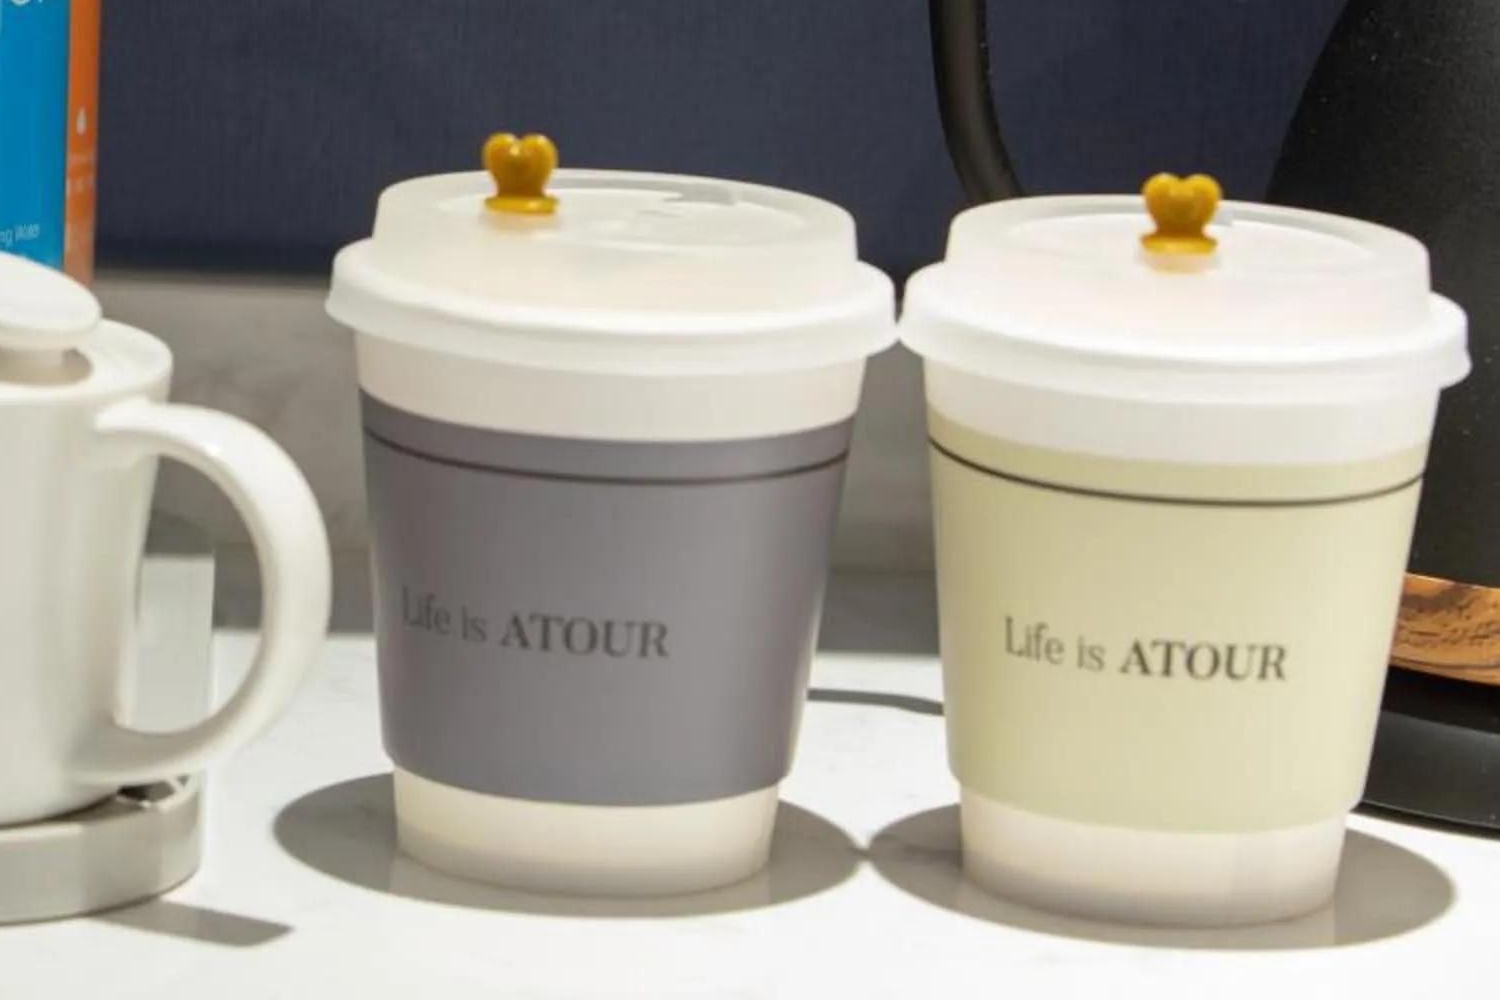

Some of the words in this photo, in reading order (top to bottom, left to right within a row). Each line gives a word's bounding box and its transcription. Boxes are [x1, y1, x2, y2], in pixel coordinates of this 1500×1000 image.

[402, 585, 452, 636] Life
[461, 604, 488, 643] is
[500, 610, 670, 659] ATOUR
[1004, 615, 1066, 665] Life
[1076, 635, 1106, 673] is
[1118, 636, 1288, 682] ATOUR
